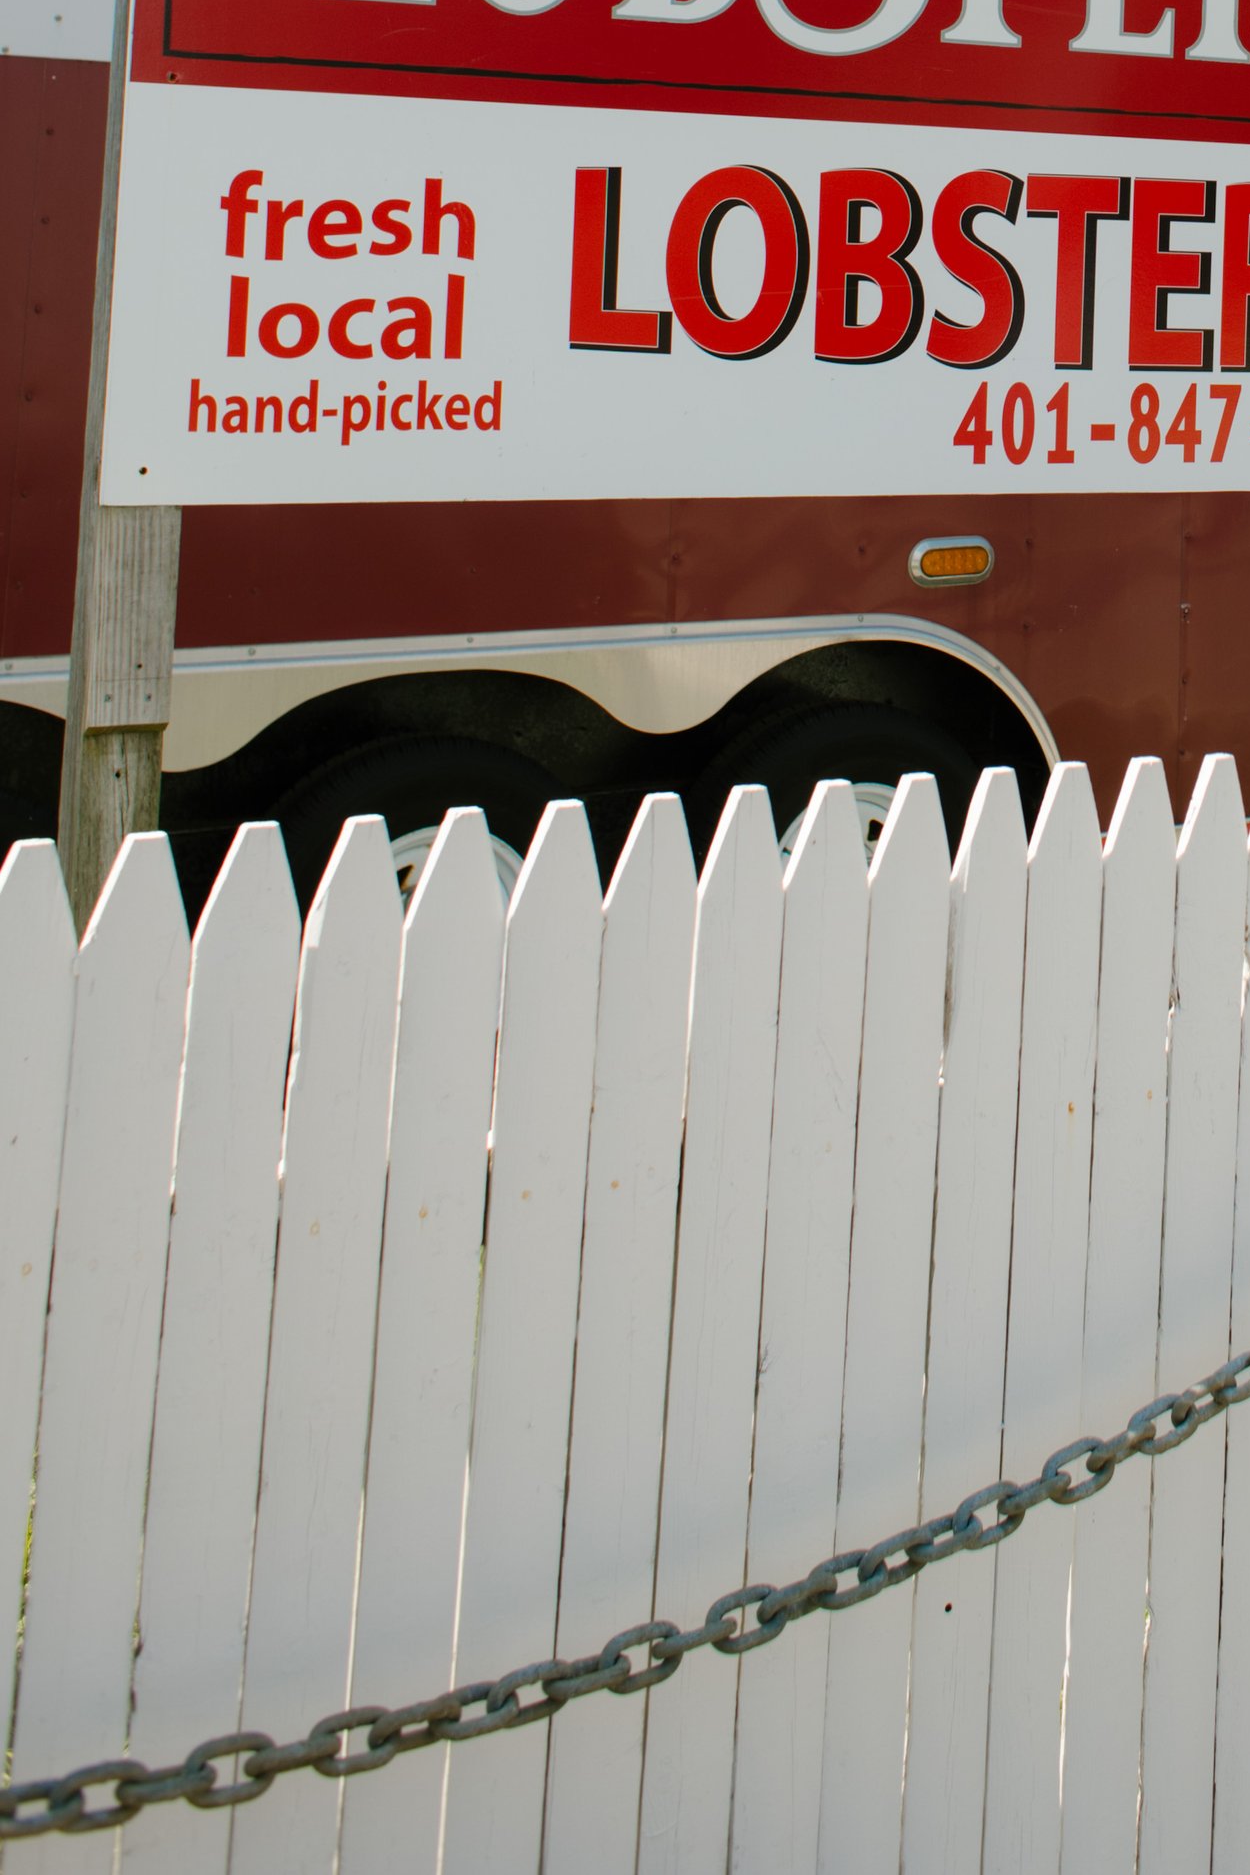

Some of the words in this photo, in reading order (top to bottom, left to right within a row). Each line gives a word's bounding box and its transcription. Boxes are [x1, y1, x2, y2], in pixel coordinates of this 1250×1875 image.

[220, 169, 477, 262] fresh
[225, 272, 467, 360] local
[187, 378, 503, 446] hand-picked
